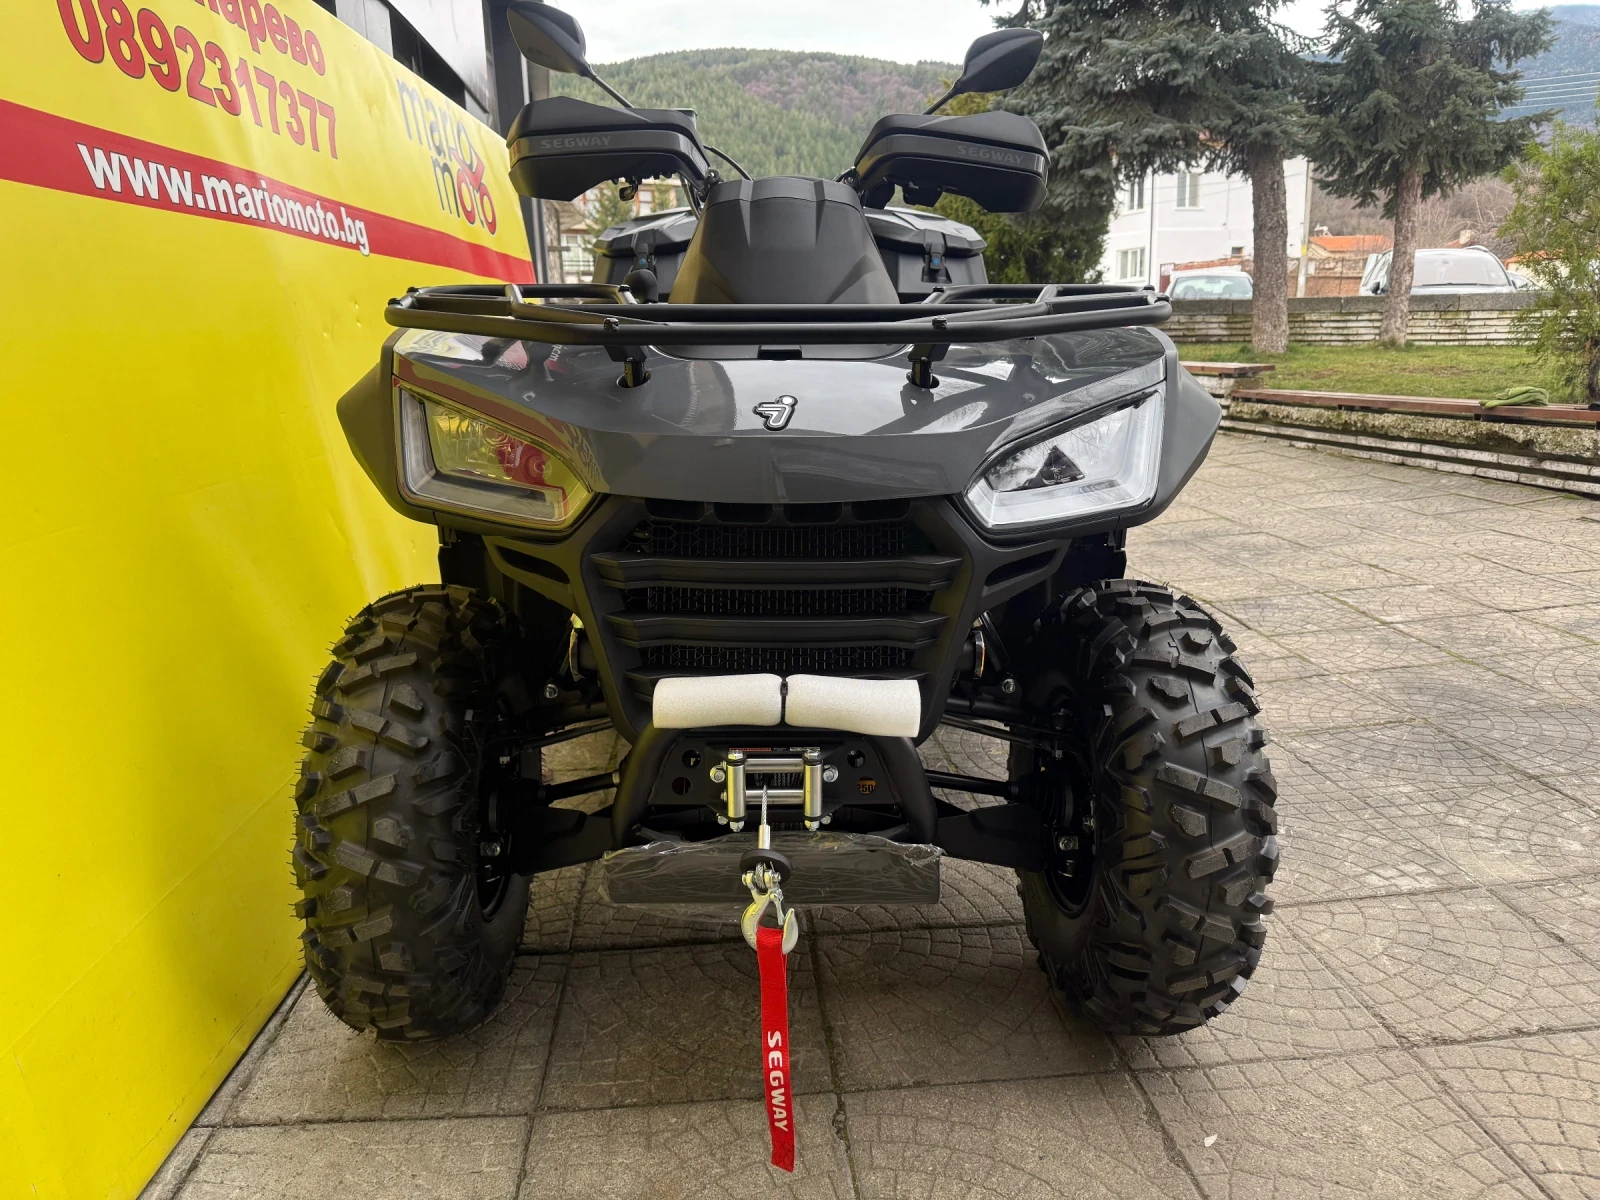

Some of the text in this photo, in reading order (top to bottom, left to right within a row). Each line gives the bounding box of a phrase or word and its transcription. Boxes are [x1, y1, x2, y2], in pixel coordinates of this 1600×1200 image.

[194, 0, 326, 76] арево
[56, 0, 339, 160] 0892317377
[541, 136, 612, 149] SEGWAY
[957, 146, 1023, 164] SEGWAY
[75, 142, 371, 257] www.mariomoto.bg
[431, 155, 497, 236] moto
[767, 1030, 788, 1132] SEGWAY
